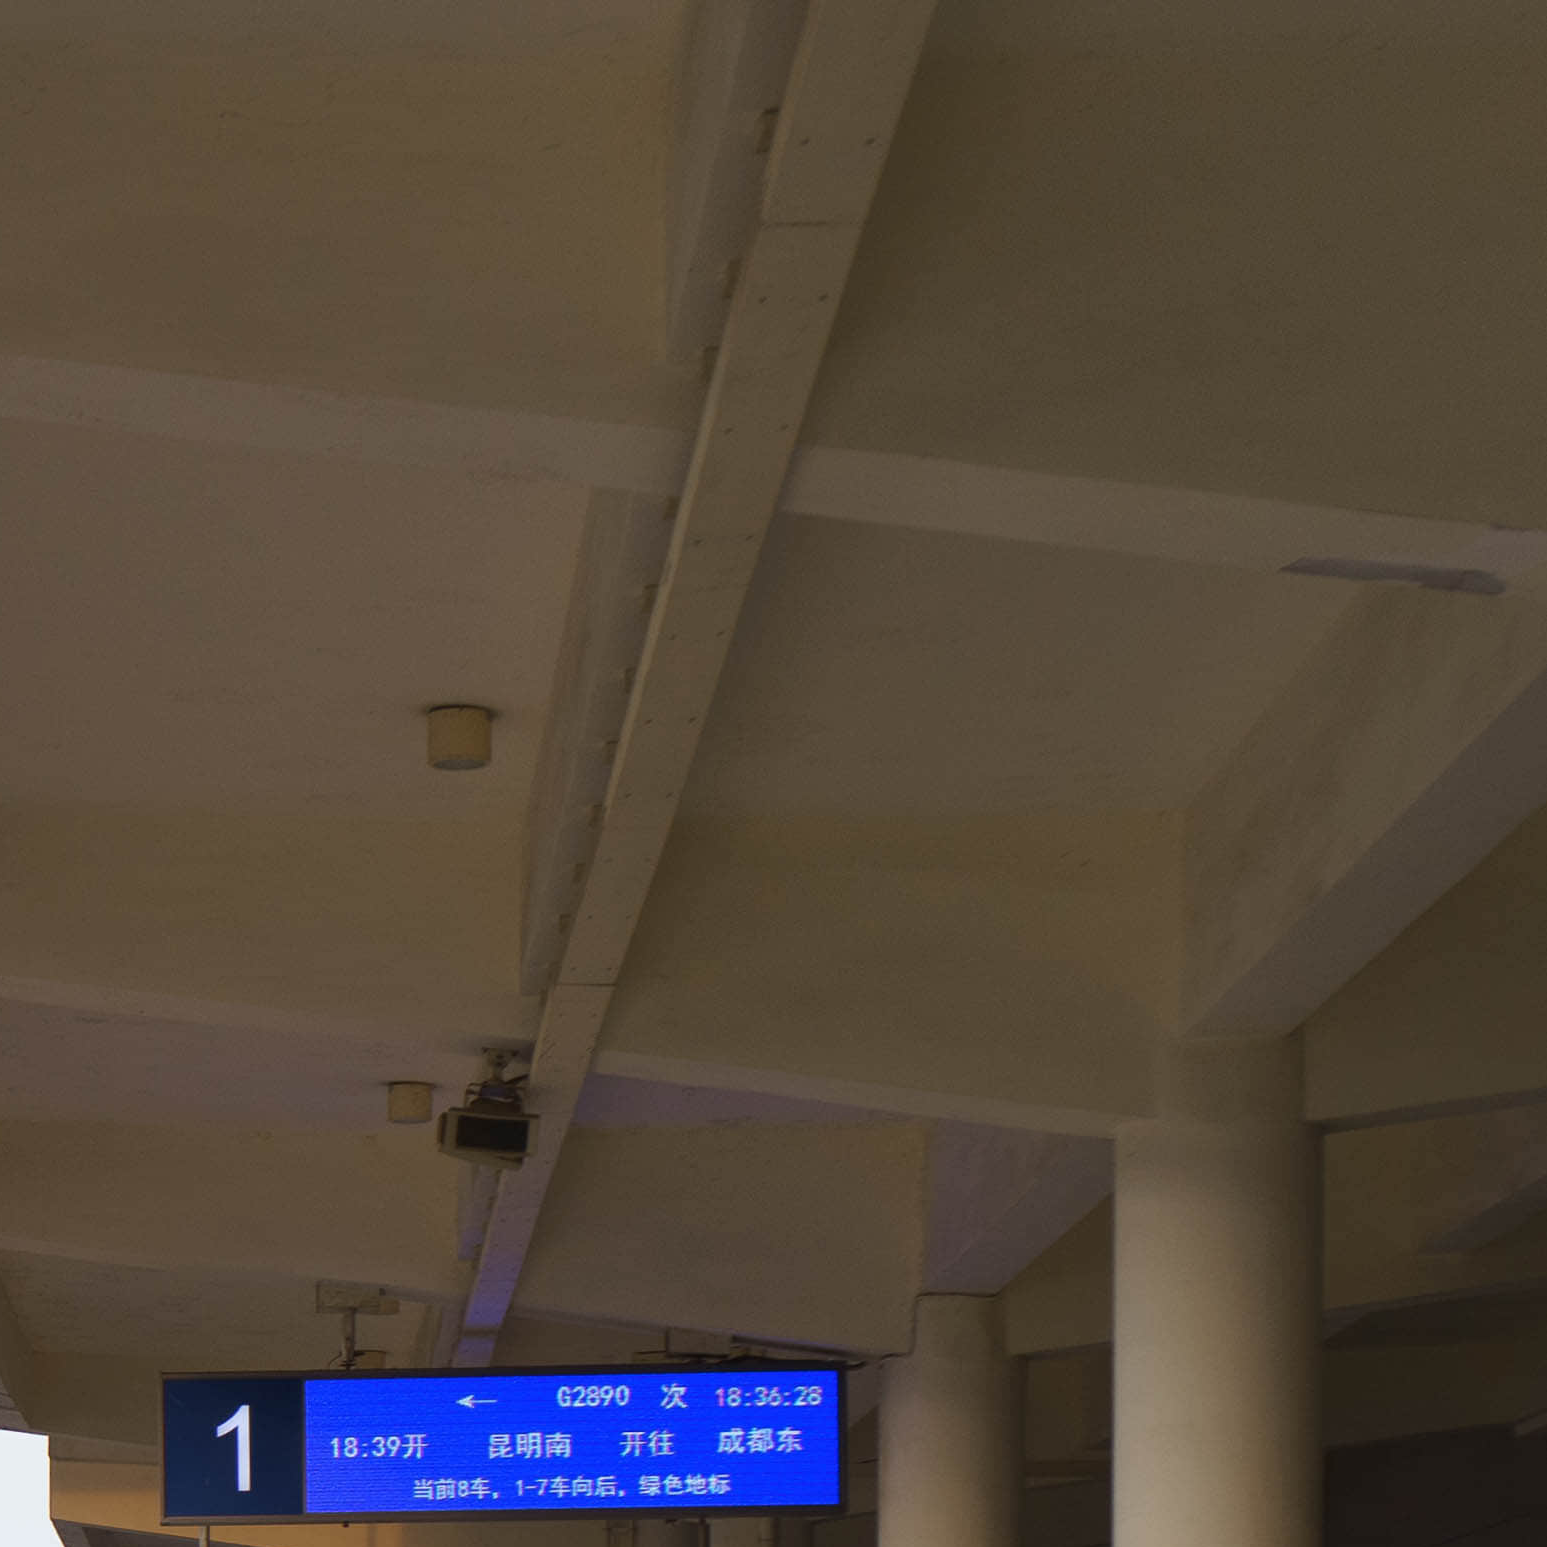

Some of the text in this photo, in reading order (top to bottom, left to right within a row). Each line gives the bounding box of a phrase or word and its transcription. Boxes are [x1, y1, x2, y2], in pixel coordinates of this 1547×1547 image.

[557, 1384, 823, 1409] G2890 次 18:36:28
[216, 1404, 251, 1491] 1
[330, 1426, 803, 1460] 18:39开 昆明南 开往 成都东
